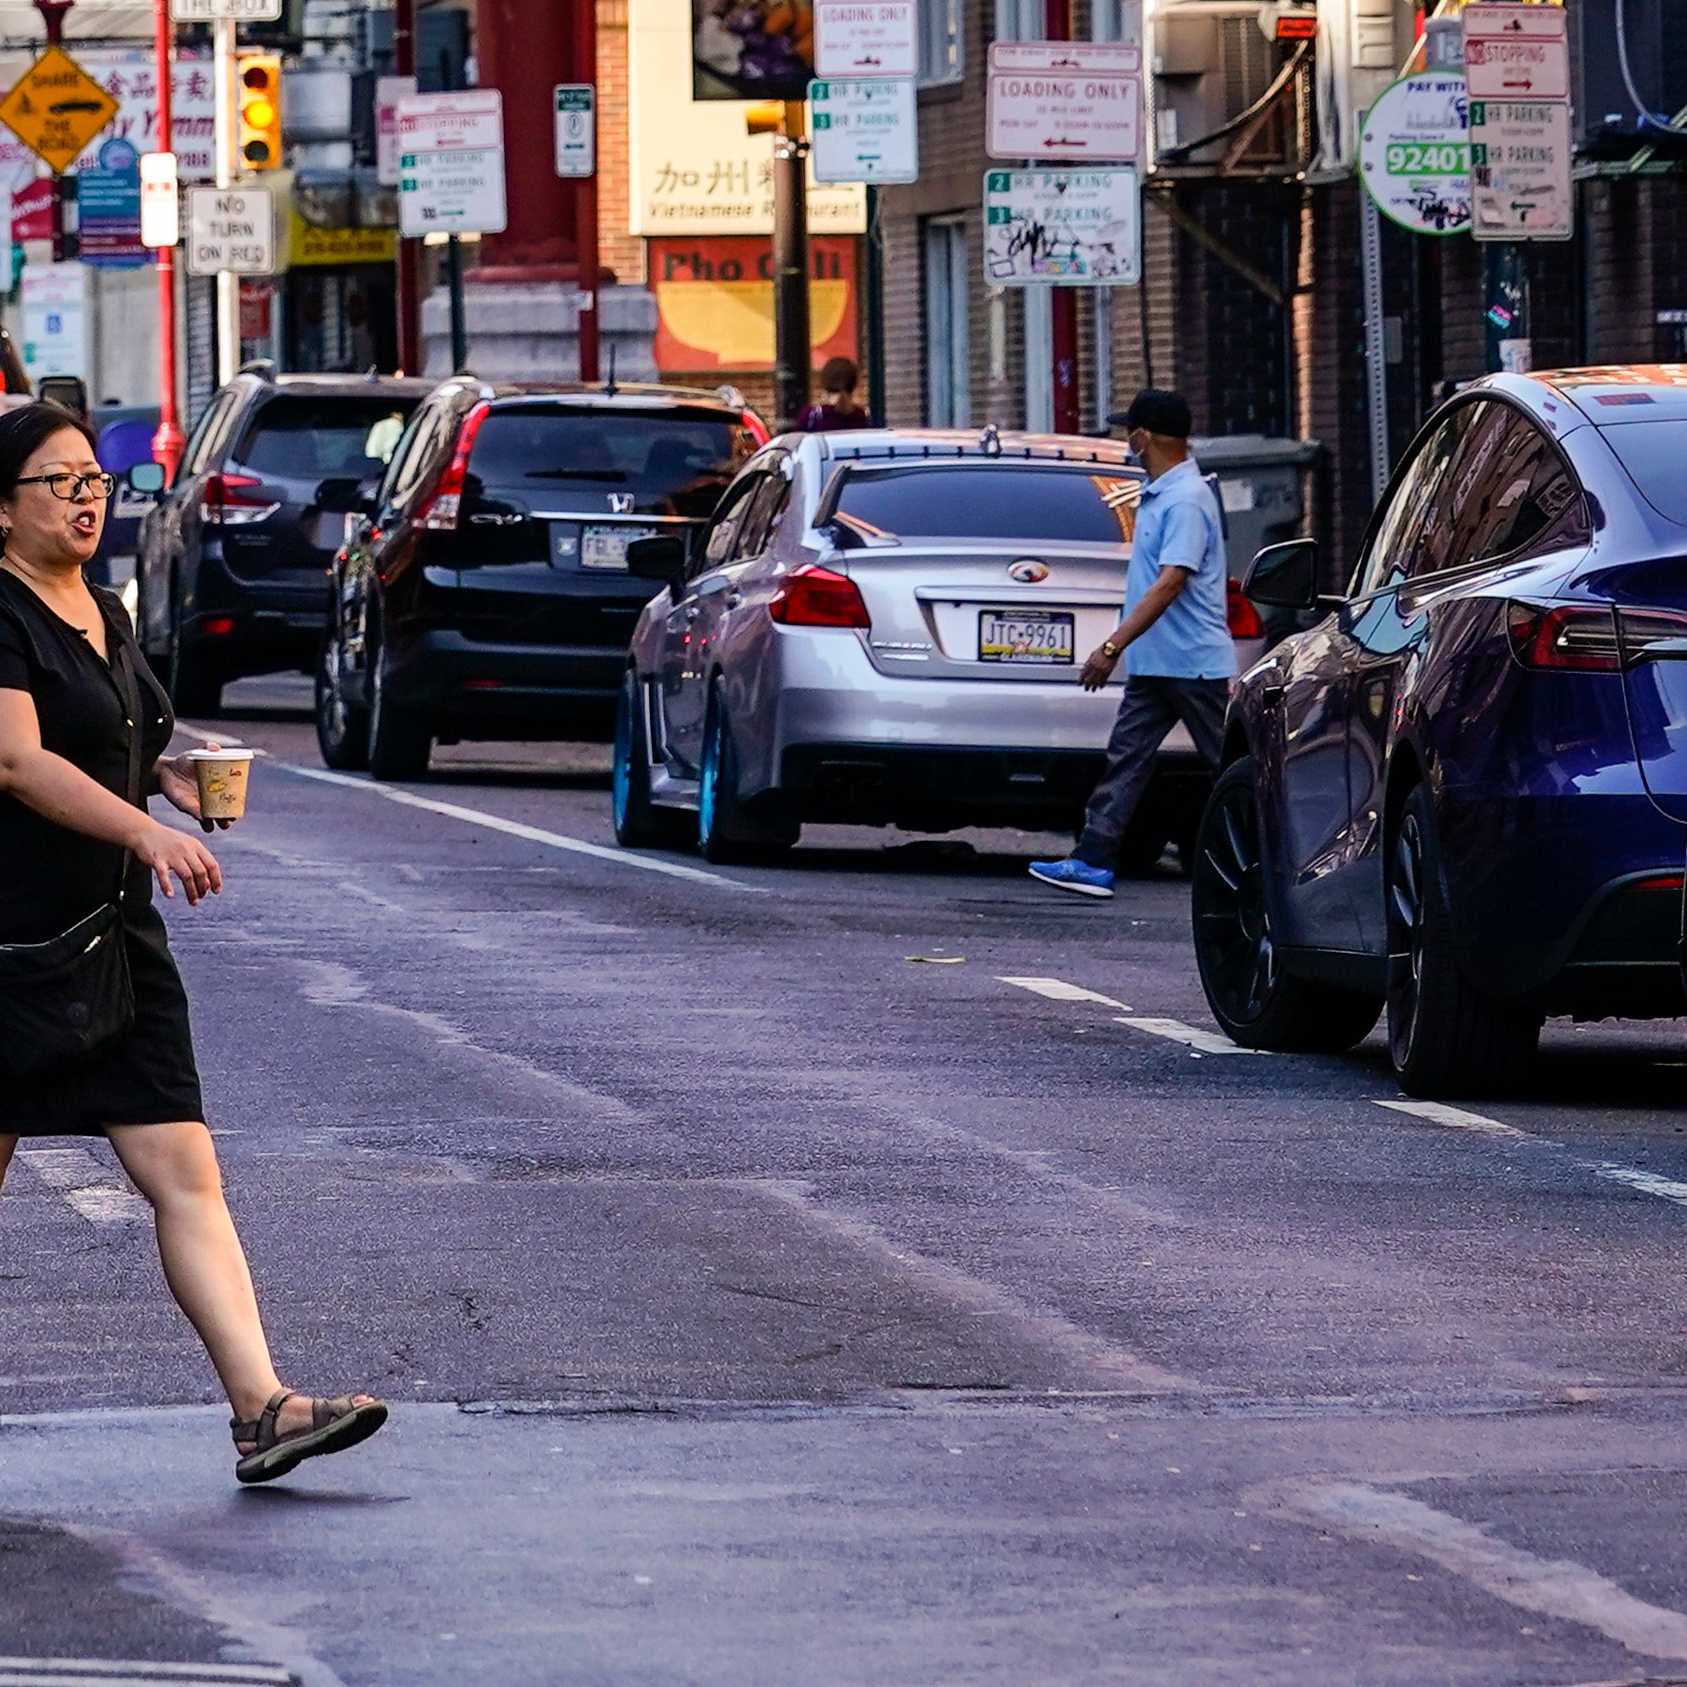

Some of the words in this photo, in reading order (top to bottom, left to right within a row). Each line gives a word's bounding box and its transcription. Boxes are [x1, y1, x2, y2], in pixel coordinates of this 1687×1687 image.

[1487, 44, 1546, 64] STOPPING
[32, 73, 78, 89] SHARE
[999, 81, 1076, 99] LOADING
[1084, 82, 1130, 100] ONLY
[1388, 145, 1469, 171] 92401
[1044, 174, 1113, 188] PARKING
[215, 197, 246, 215] NO
[208, 220, 255, 237] TURN
[197, 246, 222, 261] ON
[230, 246, 266, 262] RED
[664, 251, 742, 283] Pho
[758, 251, 841, 282] Cli
